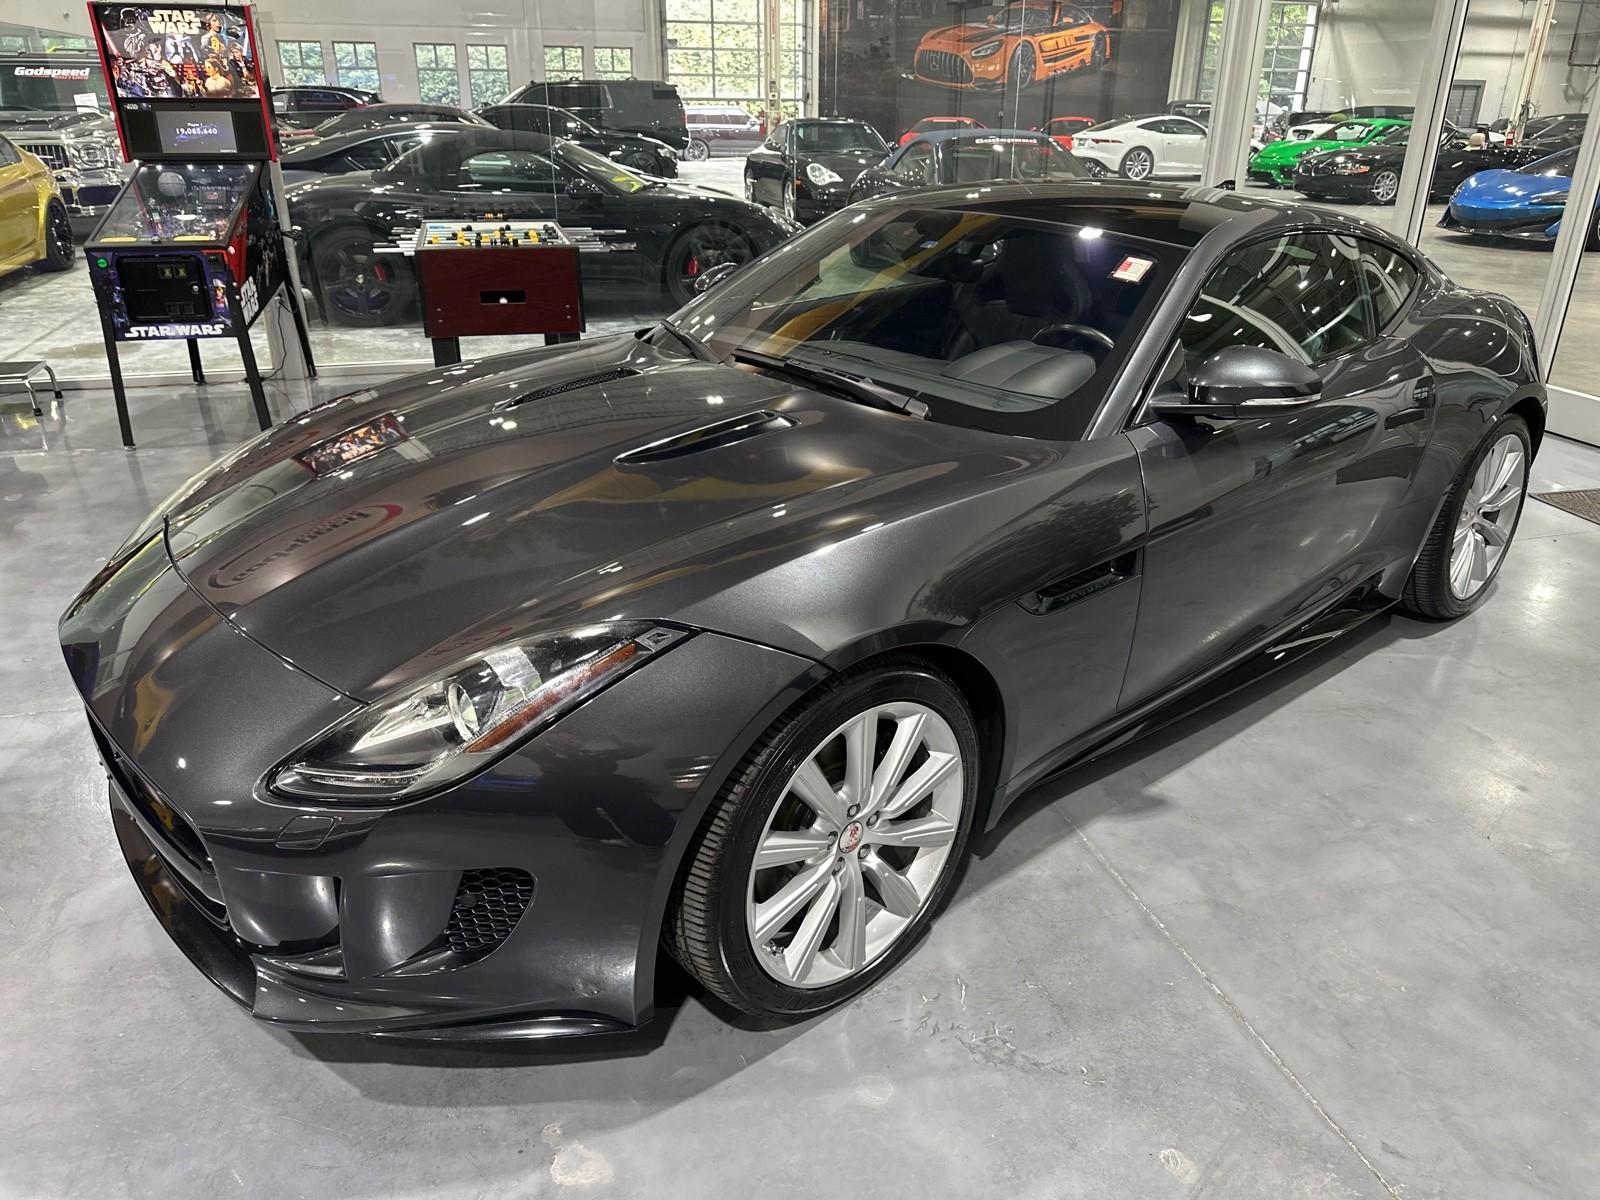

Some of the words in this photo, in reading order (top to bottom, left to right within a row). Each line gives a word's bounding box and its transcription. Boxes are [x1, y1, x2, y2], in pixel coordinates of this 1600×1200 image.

[148, 10, 200, 22] STAR
[148, 21, 201, 34] WARS
[14, 67, 90, 78] Godspeed
[124, 326, 176, 338] STAR
[175, 324, 225, 336] WARS
